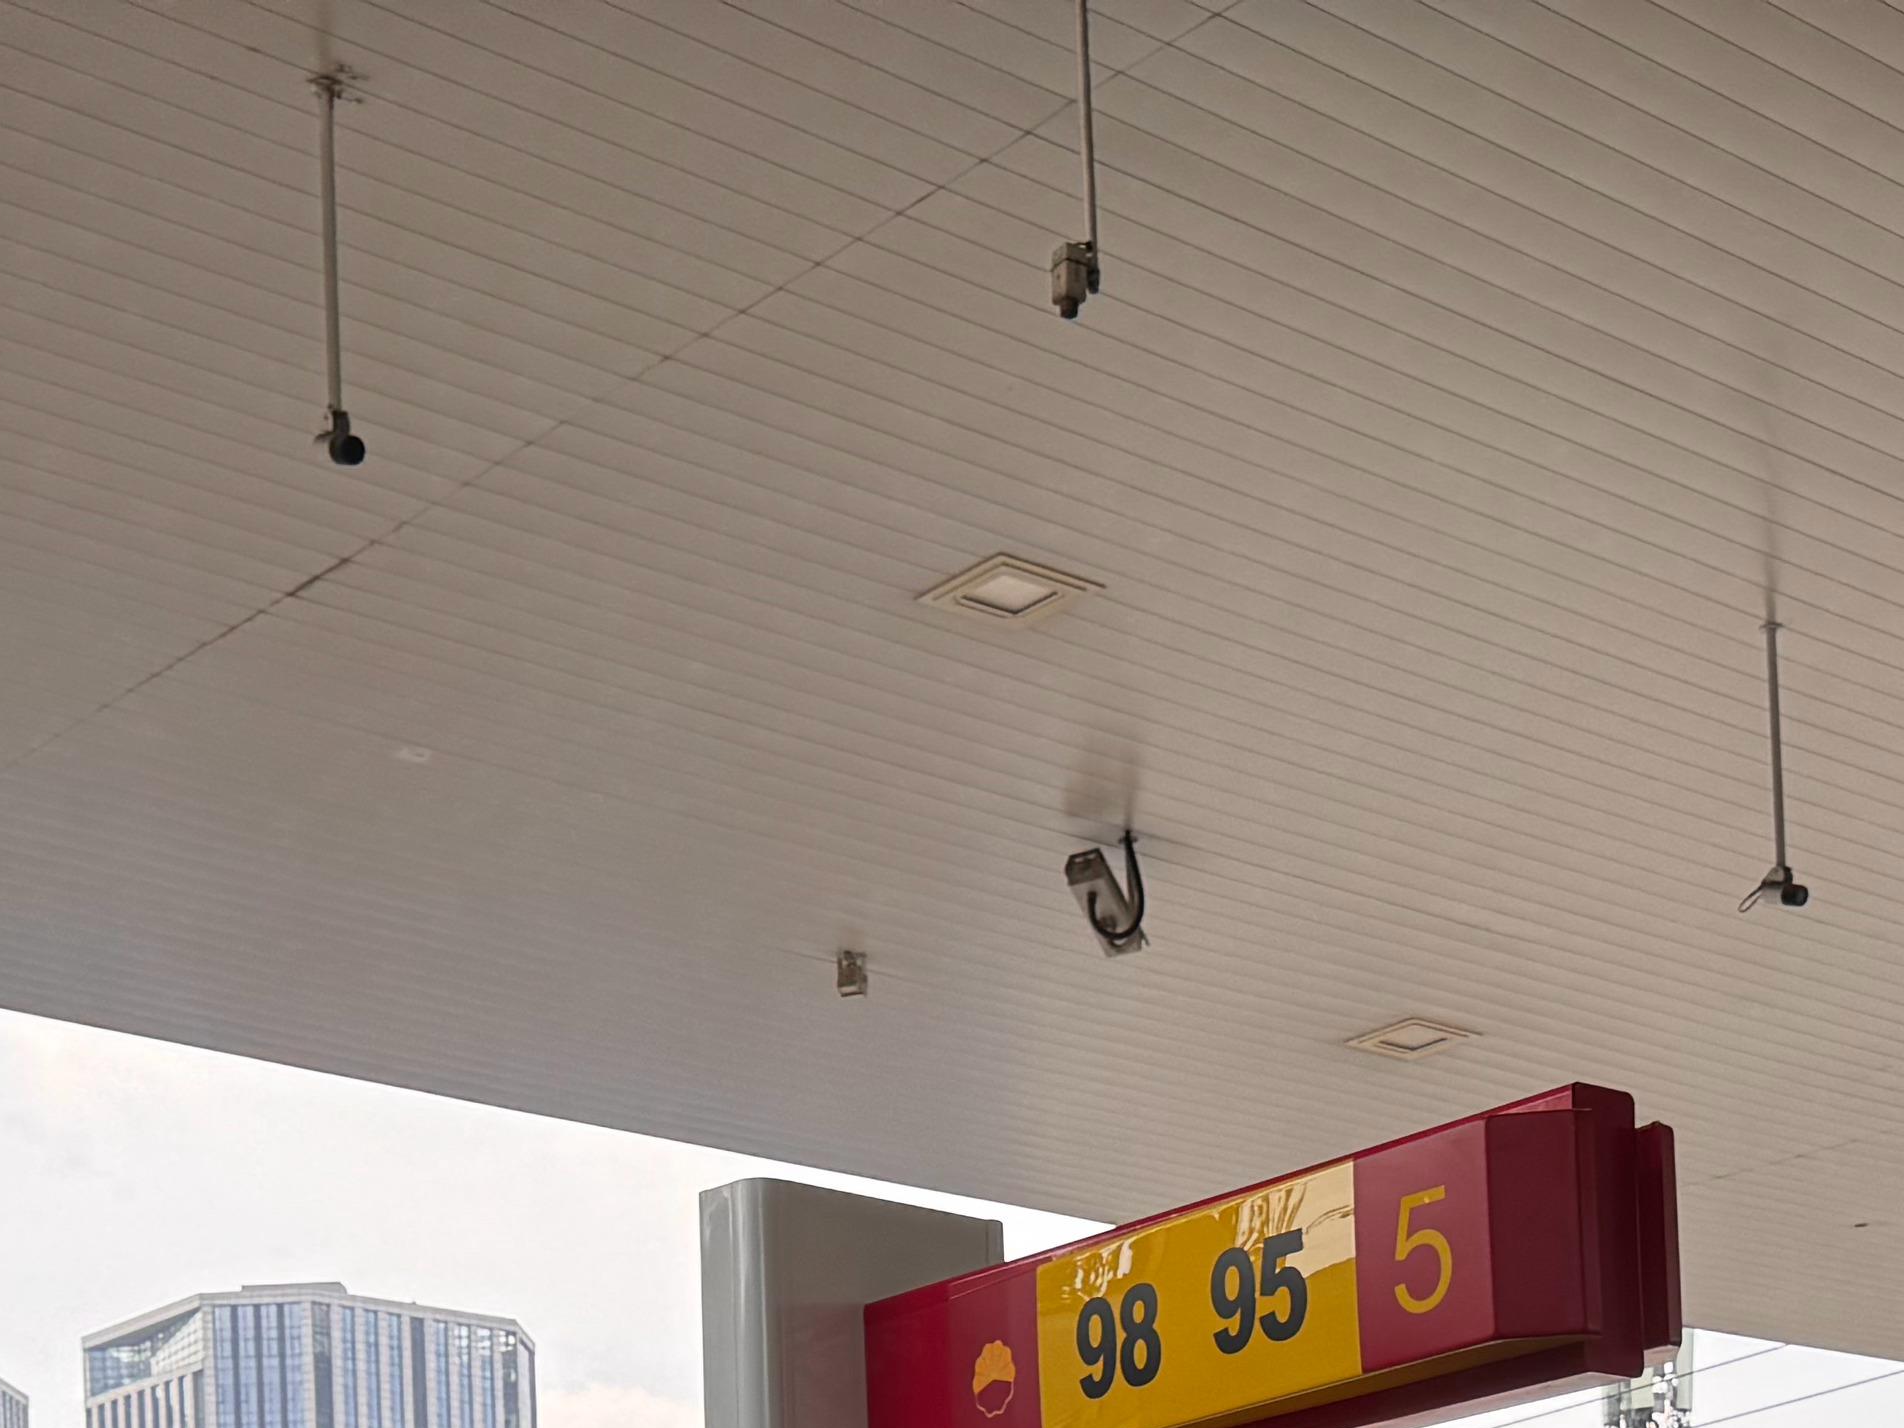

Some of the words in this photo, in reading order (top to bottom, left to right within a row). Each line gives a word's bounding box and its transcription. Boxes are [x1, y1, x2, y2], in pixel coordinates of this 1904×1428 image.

[1076, 1283, 1160, 1399] 98
[1209, 1229, 1308, 1353] 95
[1393, 1185, 1452, 1314] 5
